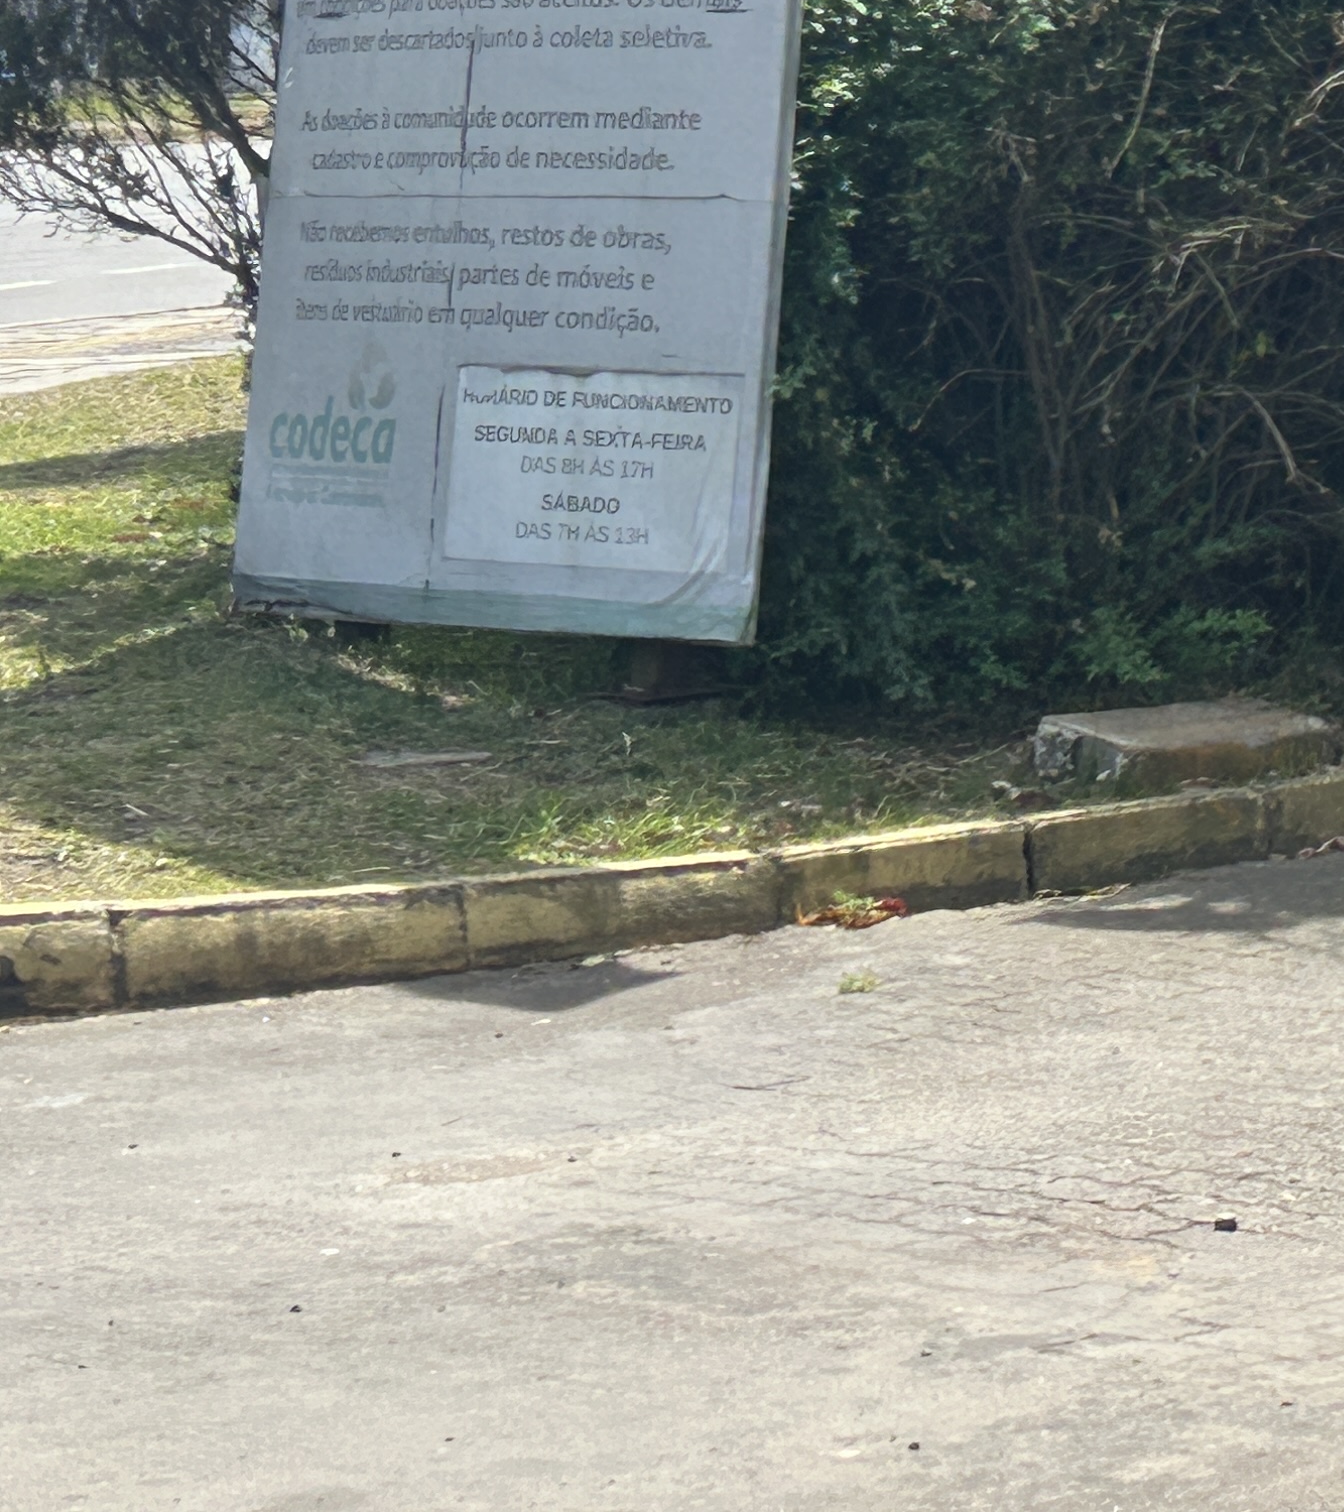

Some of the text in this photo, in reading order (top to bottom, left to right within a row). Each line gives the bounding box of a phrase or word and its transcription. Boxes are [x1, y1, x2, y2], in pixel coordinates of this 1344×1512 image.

[477, 23, 527, 55] junto
[550, 25, 613, 48] coleta
[619, 24, 712, 48] seletiva.
[502, 111, 589, 129] ocorrem
[595, 106, 701, 131] mediante
[374, 152, 383, 168] e
[506, 146, 530, 168] de
[536, 146, 674, 171] necessidade.
[502, 225, 565, 247] restos
[570, 224, 597, 247] de
[602, 224, 672, 255] obras,
[460, 264, 519, 291] partes
[525, 263, 550, 287] de
[557, 264, 635, 290] móveis
[641, 272, 655, 290] e
[331, 298, 349, 321] de
[460, 302, 549, 332] qualquer
[543, 390, 567, 408] DE
[571, 390, 734, 415] FUNCIONAMENTO
[269, 395, 396, 464] codeca
[474, 425, 706, 452] SEGUNDA A SEXTA-FEIRA
[520, 455, 556, 475] DAS
[620, 460, 654, 479] 17H
[540, 489, 621, 514] SÁBADO
[515, 521, 551, 540] DAS
